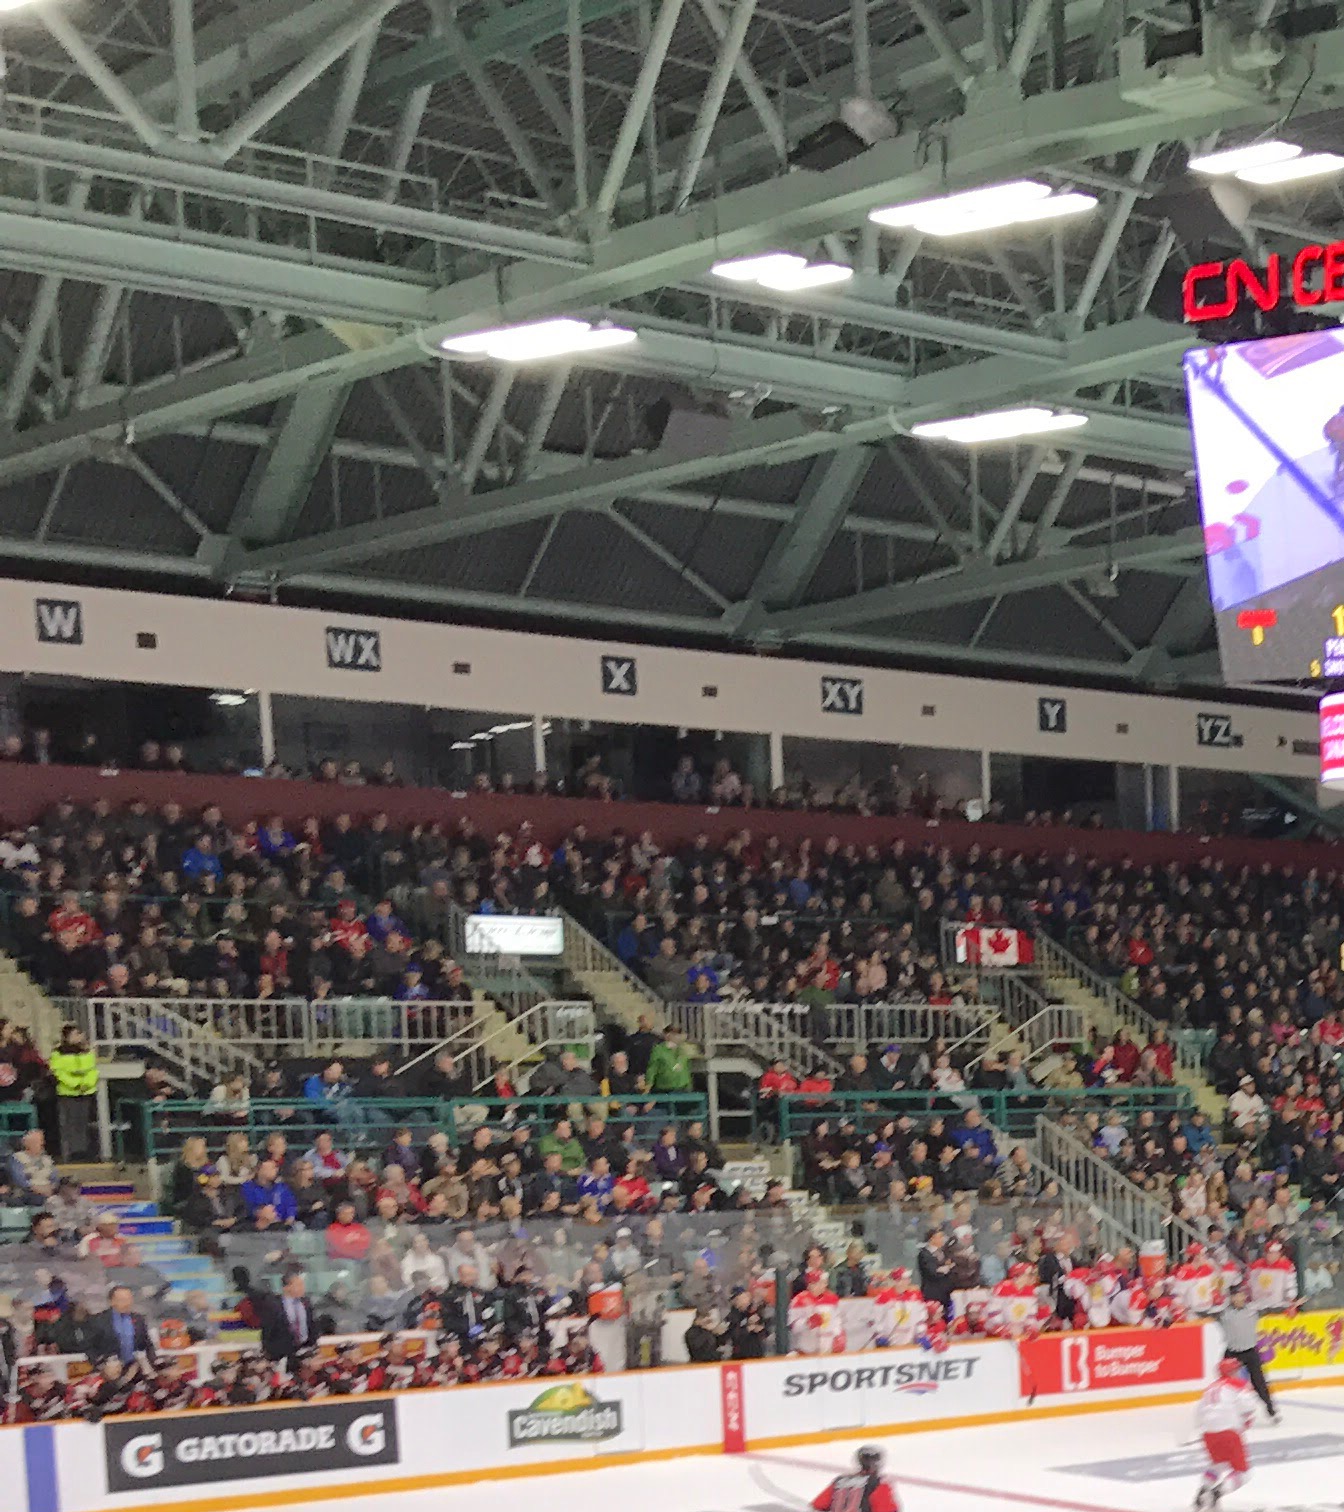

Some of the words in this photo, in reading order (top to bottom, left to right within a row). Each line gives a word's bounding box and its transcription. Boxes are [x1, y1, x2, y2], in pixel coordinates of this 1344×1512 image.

[1184, 252, 1280, 322] CN
[39, 604, 77, 638] W
[328, 632, 381, 667] WX
[606, 660, 632, 692] X
[822, 680, 864, 711] XY
[1043, 701, 1062, 730] Y
[1197, 717, 1231, 745] YZ
[782, 1356, 980, 1398] SPORTSNET
[512, 1405, 619, 1440] Cavendish
[120, 1433, 165, 1478] G
[174, 1424, 336, 1463] GATORADE
[345, 1412, 387, 1456] G
